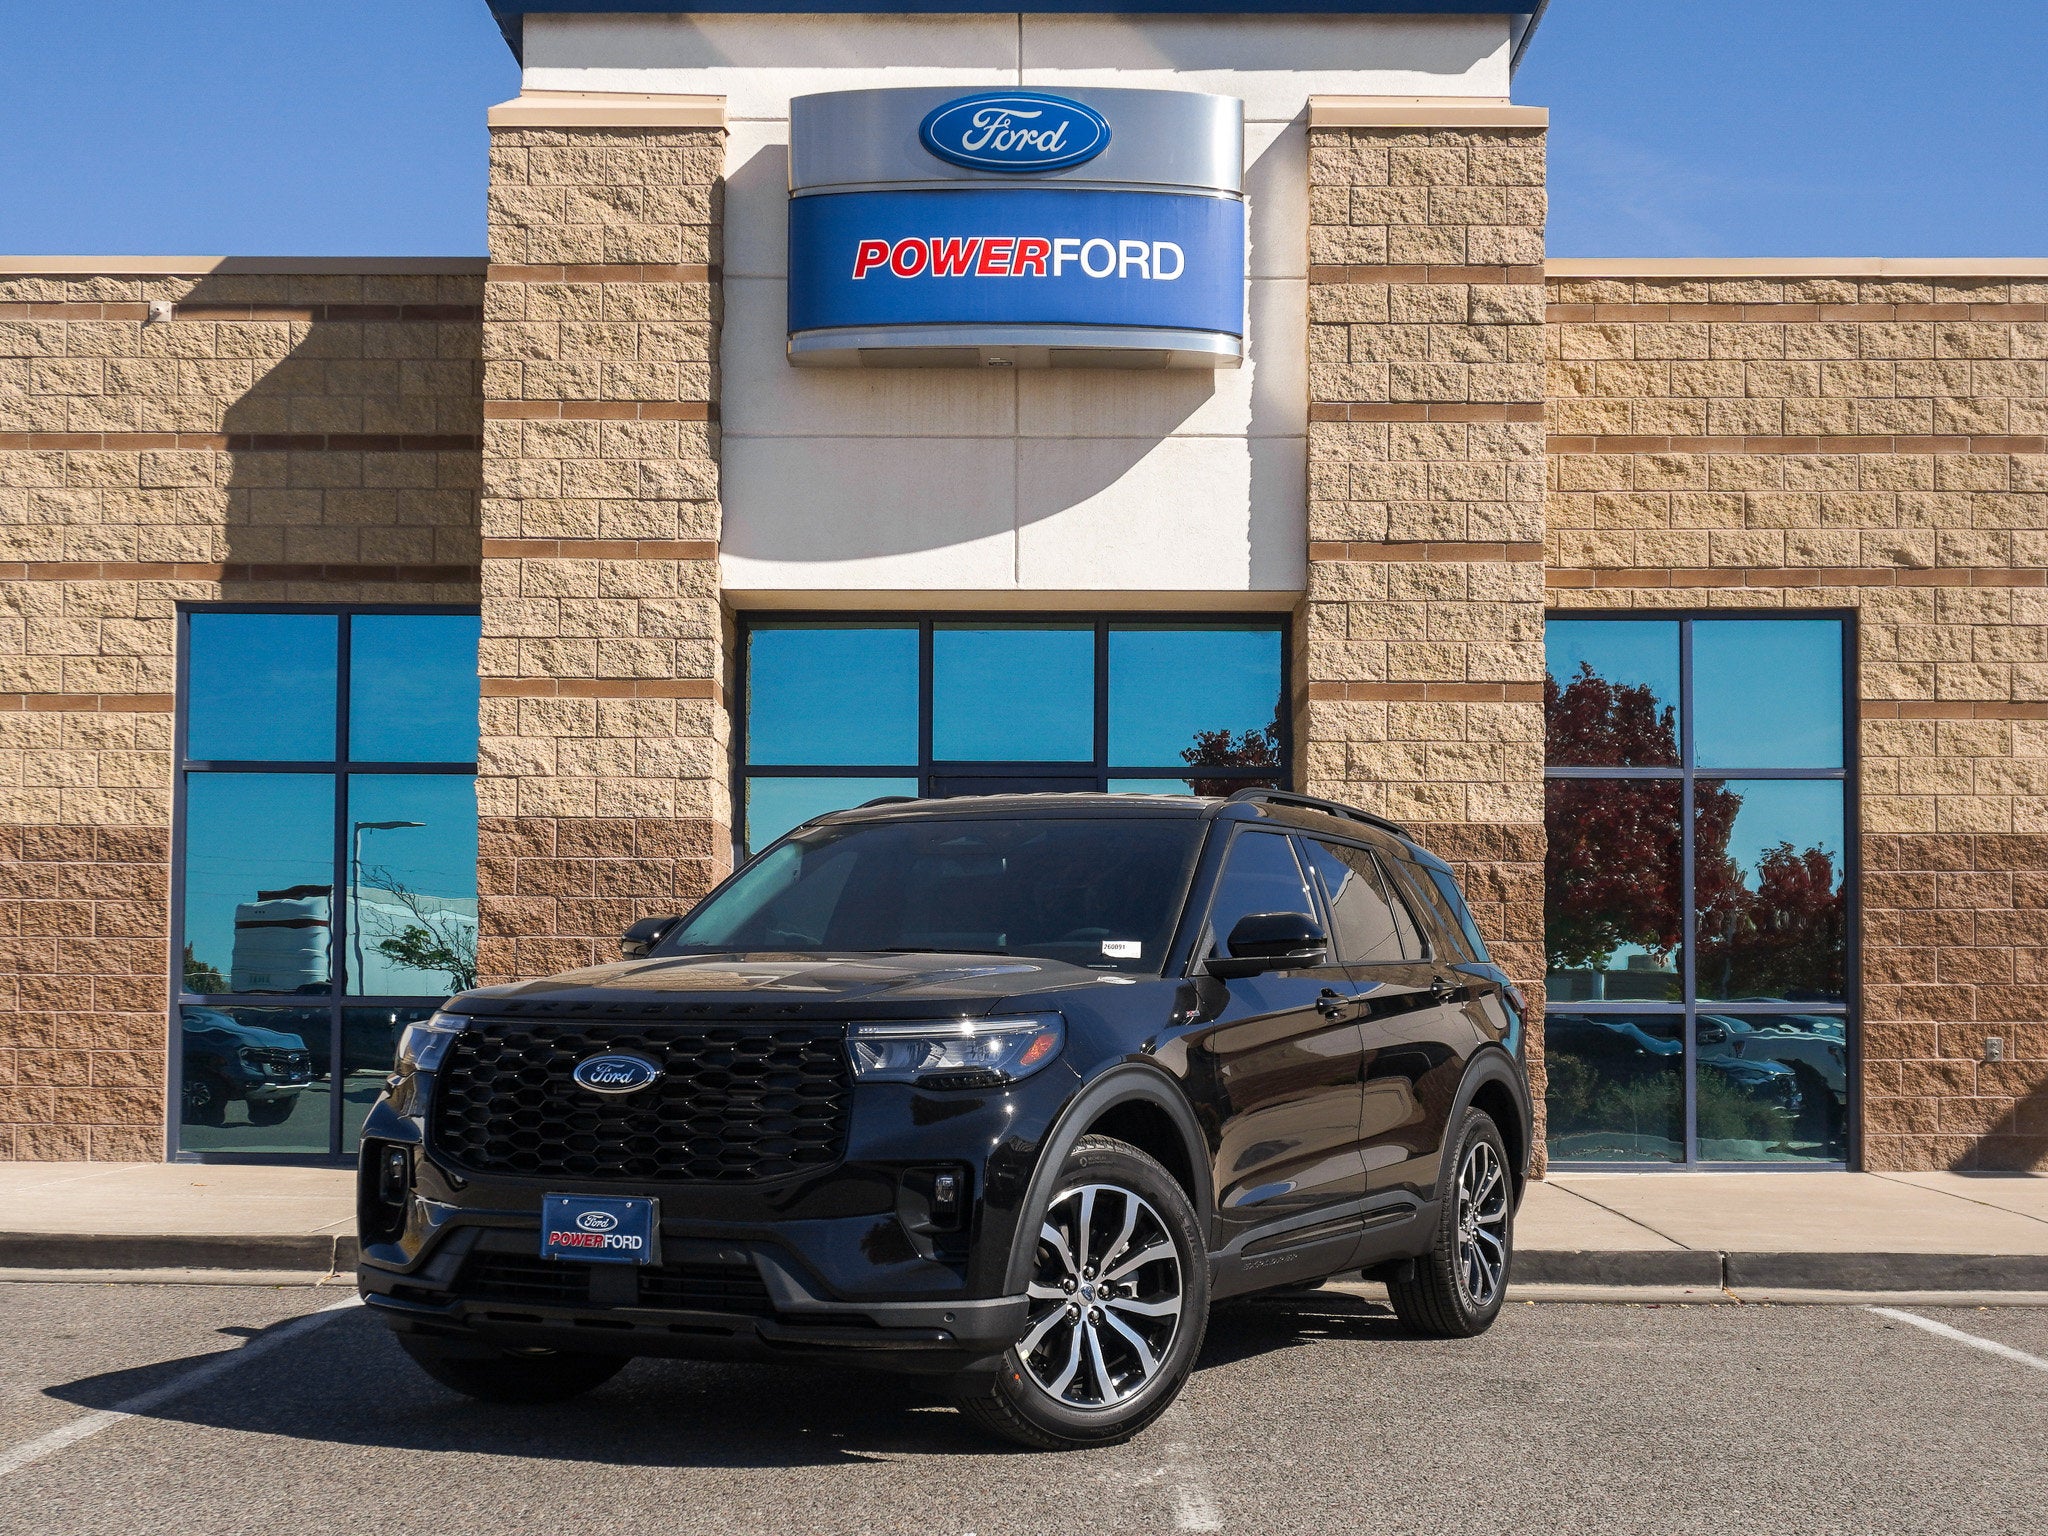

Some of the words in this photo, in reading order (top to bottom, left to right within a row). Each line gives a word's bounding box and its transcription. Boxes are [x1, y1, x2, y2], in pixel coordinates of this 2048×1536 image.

[961, 107, 1070, 153] Ford
[589, 1062, 636, 1085] Ford
[583, 1214, 610, 1228] Ford
